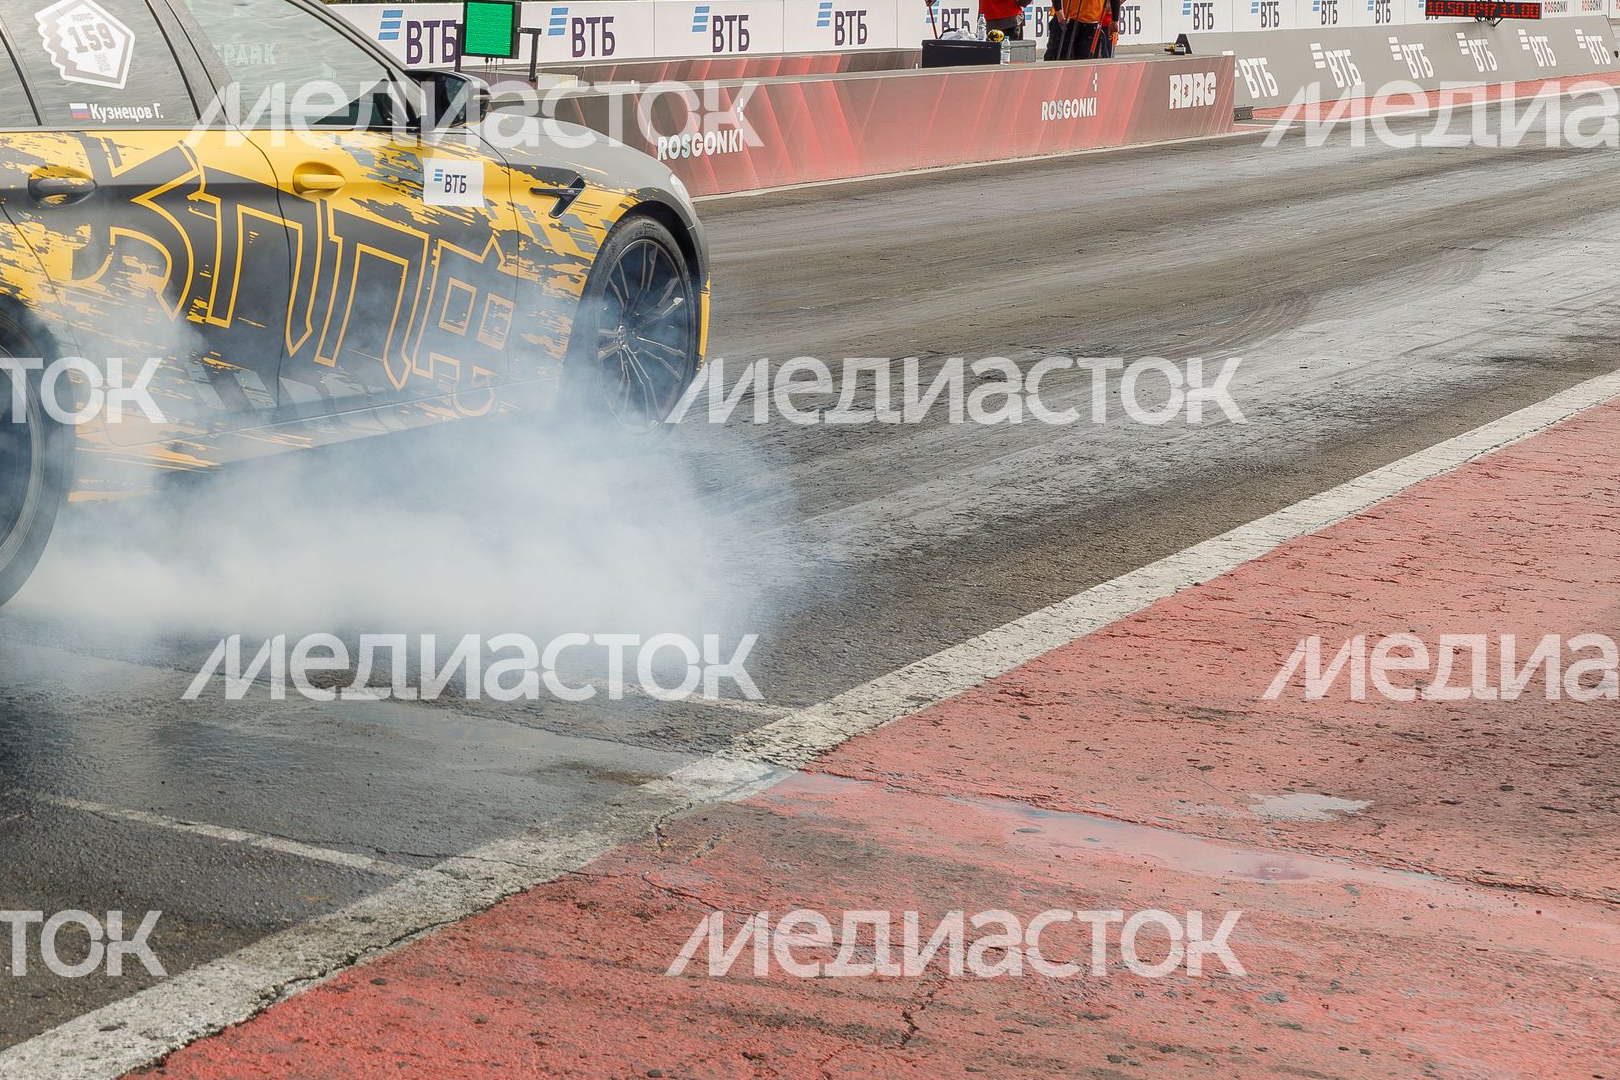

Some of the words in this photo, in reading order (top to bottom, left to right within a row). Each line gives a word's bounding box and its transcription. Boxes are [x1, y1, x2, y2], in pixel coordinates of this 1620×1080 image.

[1192, 2, 1214, 31] ВТБ
[1260, 0, 1280, 28] ВТБ
[1321, 0, 1338, 26] ВТБ
[1375, 0, 1391, 24] ВТБ
[1427, 1, 1465, 16] 10.50
[1501, 3, 1539, 19] 11.00
[68, 23, 115, 53] 159
[406, 19, 457, 65] ВТБ
[571, 15, 615, 58] ВТБ
[712, 14, 750, 53] ВТБ
[834, 9, 867, 46] ВТБ
[1401, 43, 1434, 80] ВТБ
[1468, 39, 1498, 73] ВТБ
[1529, 35, 1557, 67] ВТБ
[1584, 35, 1611, 65] ВТБ
[1239, 57, 1279, 99] ВТБ
[1325, 49, 1362, 89] ВТБ
[1169, 72, 1217, 109] RDRC
[89, 103, 152, 123] Кузнецов
[153, 103, 164, 119] Г.
[1041, 97, 1097, 121] ROSGONKI
[657, 128, 744, 161] ROSGONKI
[444, 174, 467, 193] ВТБ
